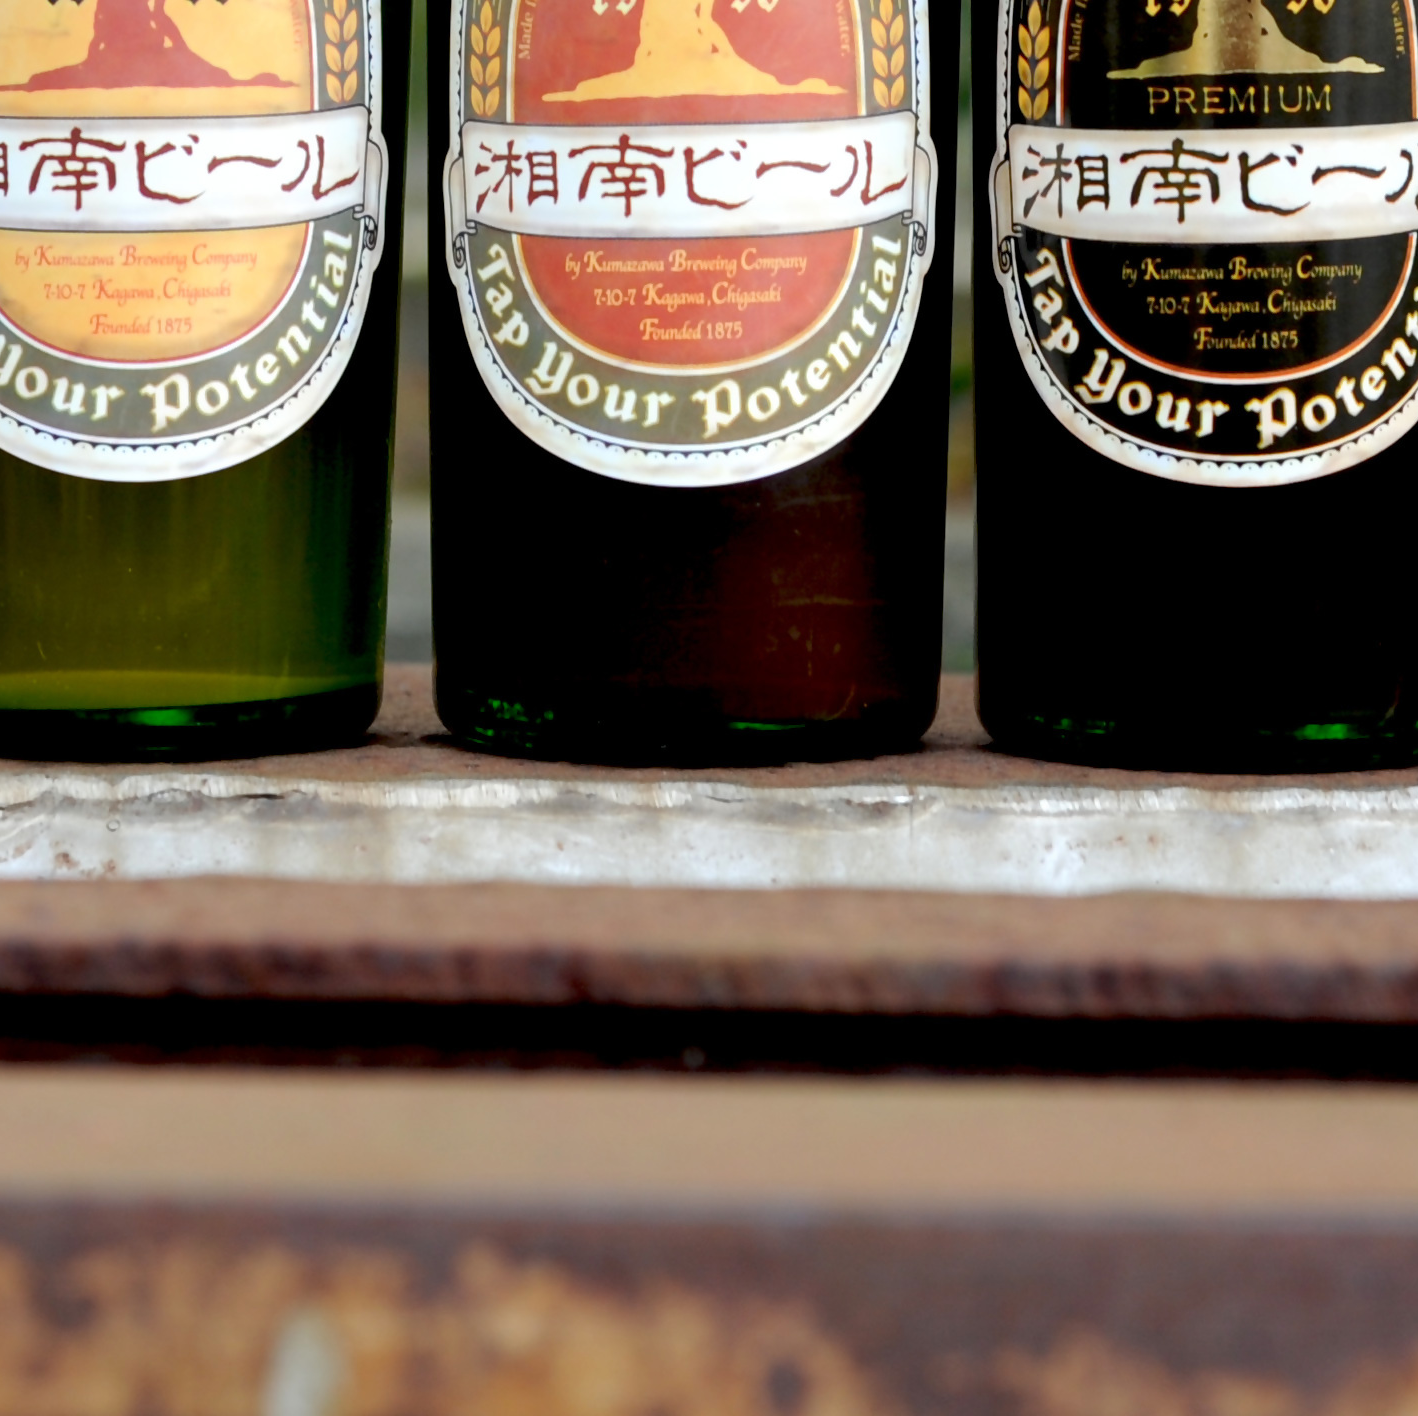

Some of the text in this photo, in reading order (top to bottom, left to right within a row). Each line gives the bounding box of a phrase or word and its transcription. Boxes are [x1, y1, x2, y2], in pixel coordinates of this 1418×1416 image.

[518, 12, 534, 60] Made
[1068, 13, 1084, 61] Made
[1149, 85, 1332, 114] PREMIUM
[474, 134, 909, 217] 湘南ビール
[15, 248, 29, 273] by
[34, 245, 114, 266] Kumazawa
[192, 243, 257, 273] Company
[565, 253, 580, 279] by
[584, 251, 664, 273] Kumazawa
[741, 248, 807, 276] Company
[1122, 260, 1137, 288] by
[1141, 258, 1224, 280] Kumazawa
[1297, 255, 1362, 284] Company
[44, 284, 85, 299] 7-10-7
[163, 277, 231, 305] Chigasaki
[594, 288, 636, 306] 7-10-7
[712, 282, 781, 310] Chigasaki
[1147, 297, 1190, 314] 7-10-7
[1268, 289, 1337, 320] Chigasaki
[90, 314, 192, 334] Founded 1875
[141, 230, 353, 432] Potential
[477, 234, 903, 440] Tap Your Potential
[640, 318, 743, 340] Founded 1875
[1194, 327, 1298, 349] Founded 1875
[1025, 248, 1081, 355] Tap
[1075, 348, 1229, 438] Your
